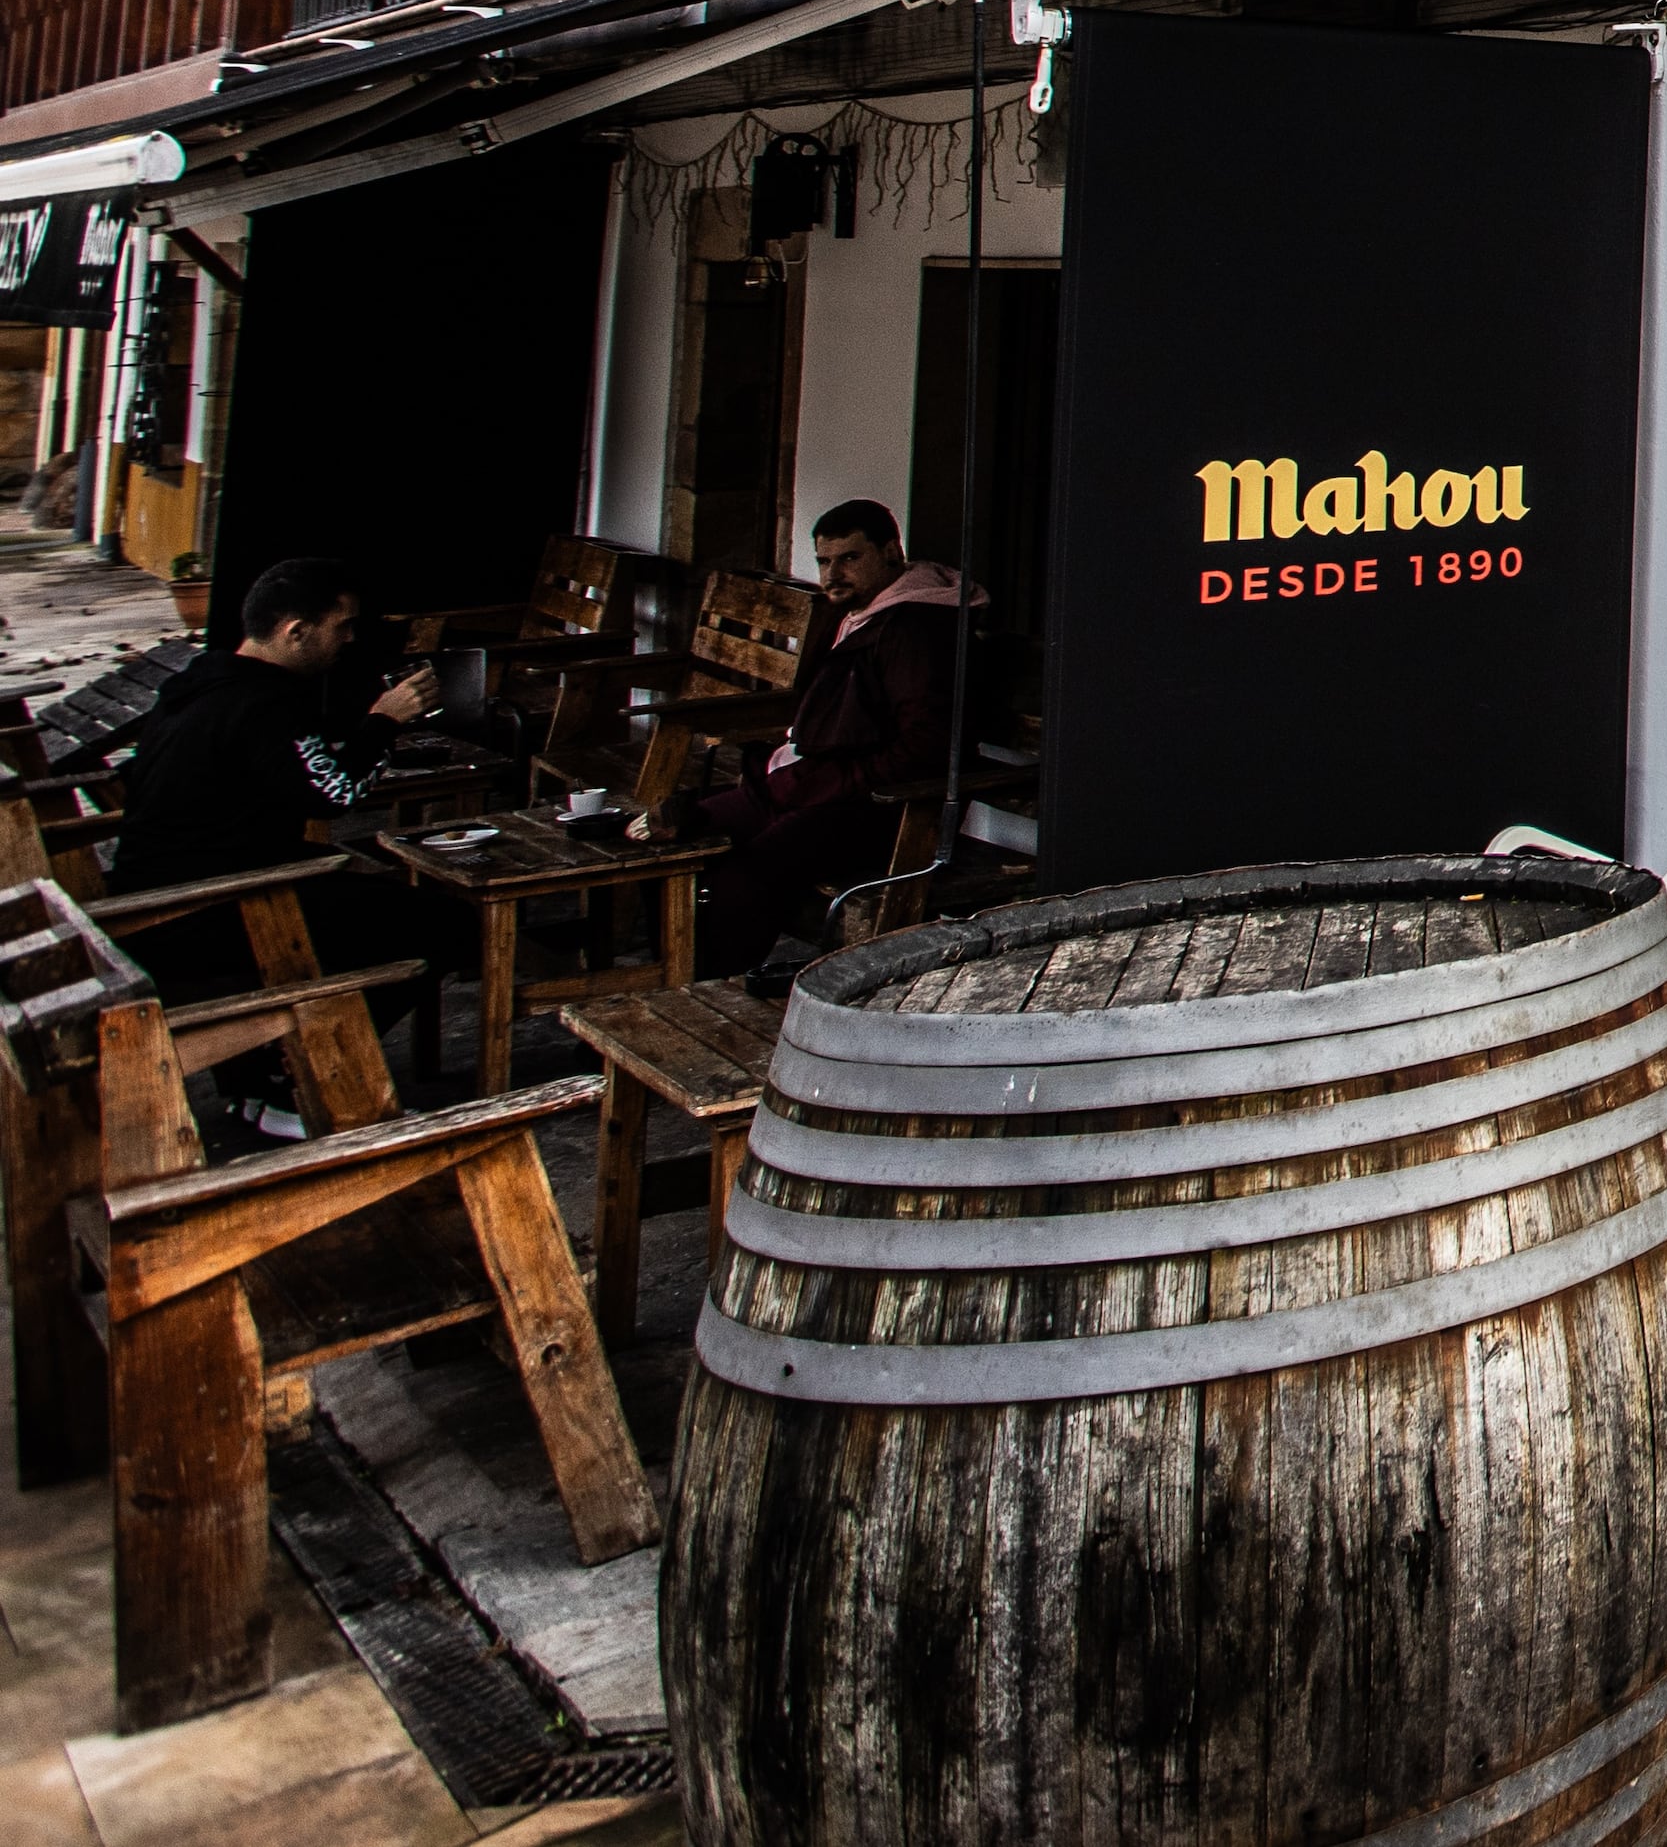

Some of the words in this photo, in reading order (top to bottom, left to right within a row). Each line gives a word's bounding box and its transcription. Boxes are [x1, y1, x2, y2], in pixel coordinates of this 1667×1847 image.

[1195, 450, 1530, 543] Mahou
[1201, 559, 1378, 604] DESDE
[1410, 547, 1523, 586] 1890
